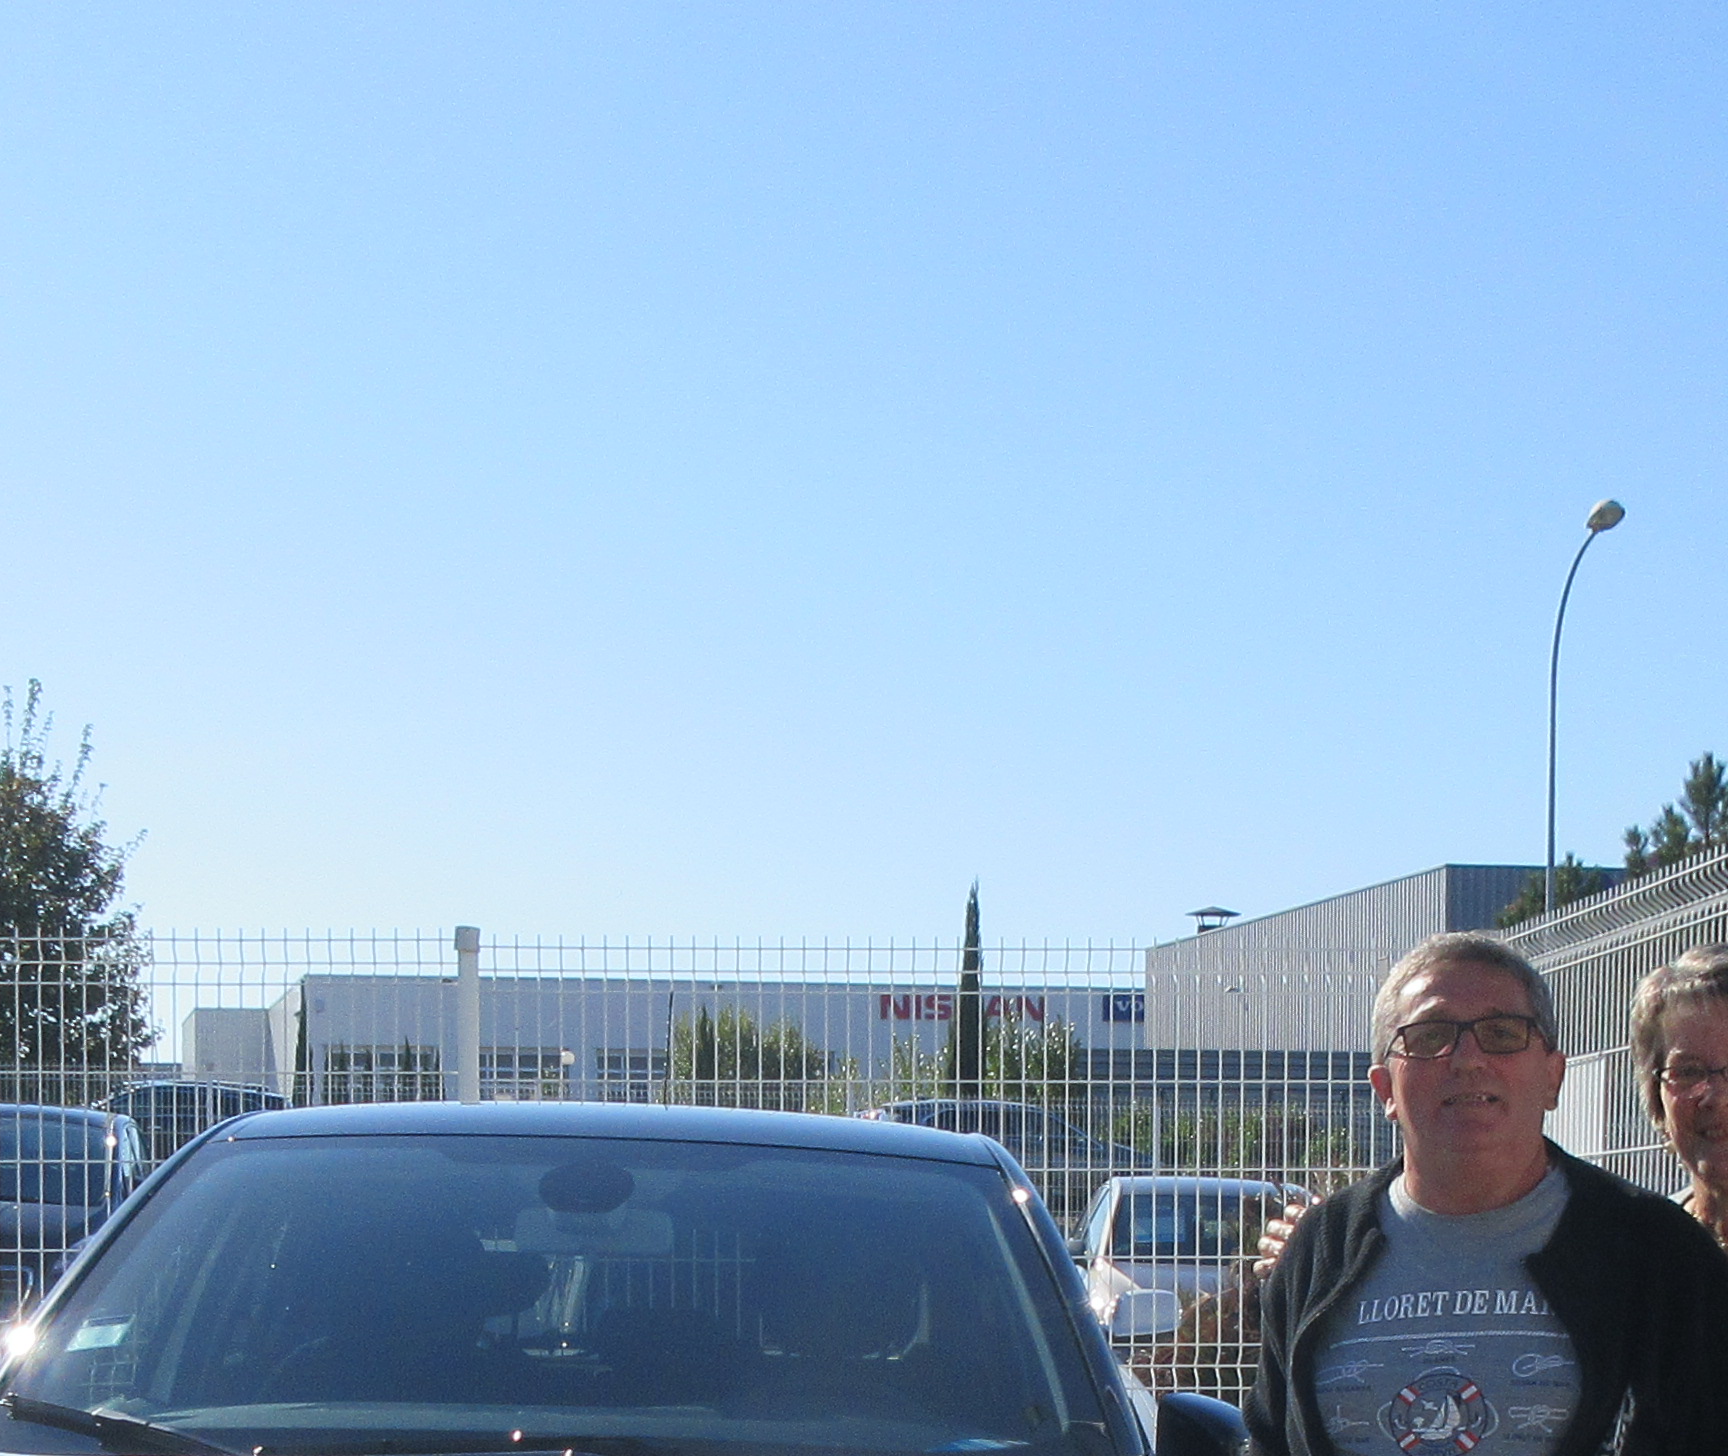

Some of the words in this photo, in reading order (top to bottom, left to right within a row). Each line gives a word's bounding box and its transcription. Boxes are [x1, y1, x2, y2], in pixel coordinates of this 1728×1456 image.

[880, 994, 1045, 1022] NISAN
[1357, 1291, 1450, 1325] LLORET
[1452, 1290, 1489, 1315] DE
